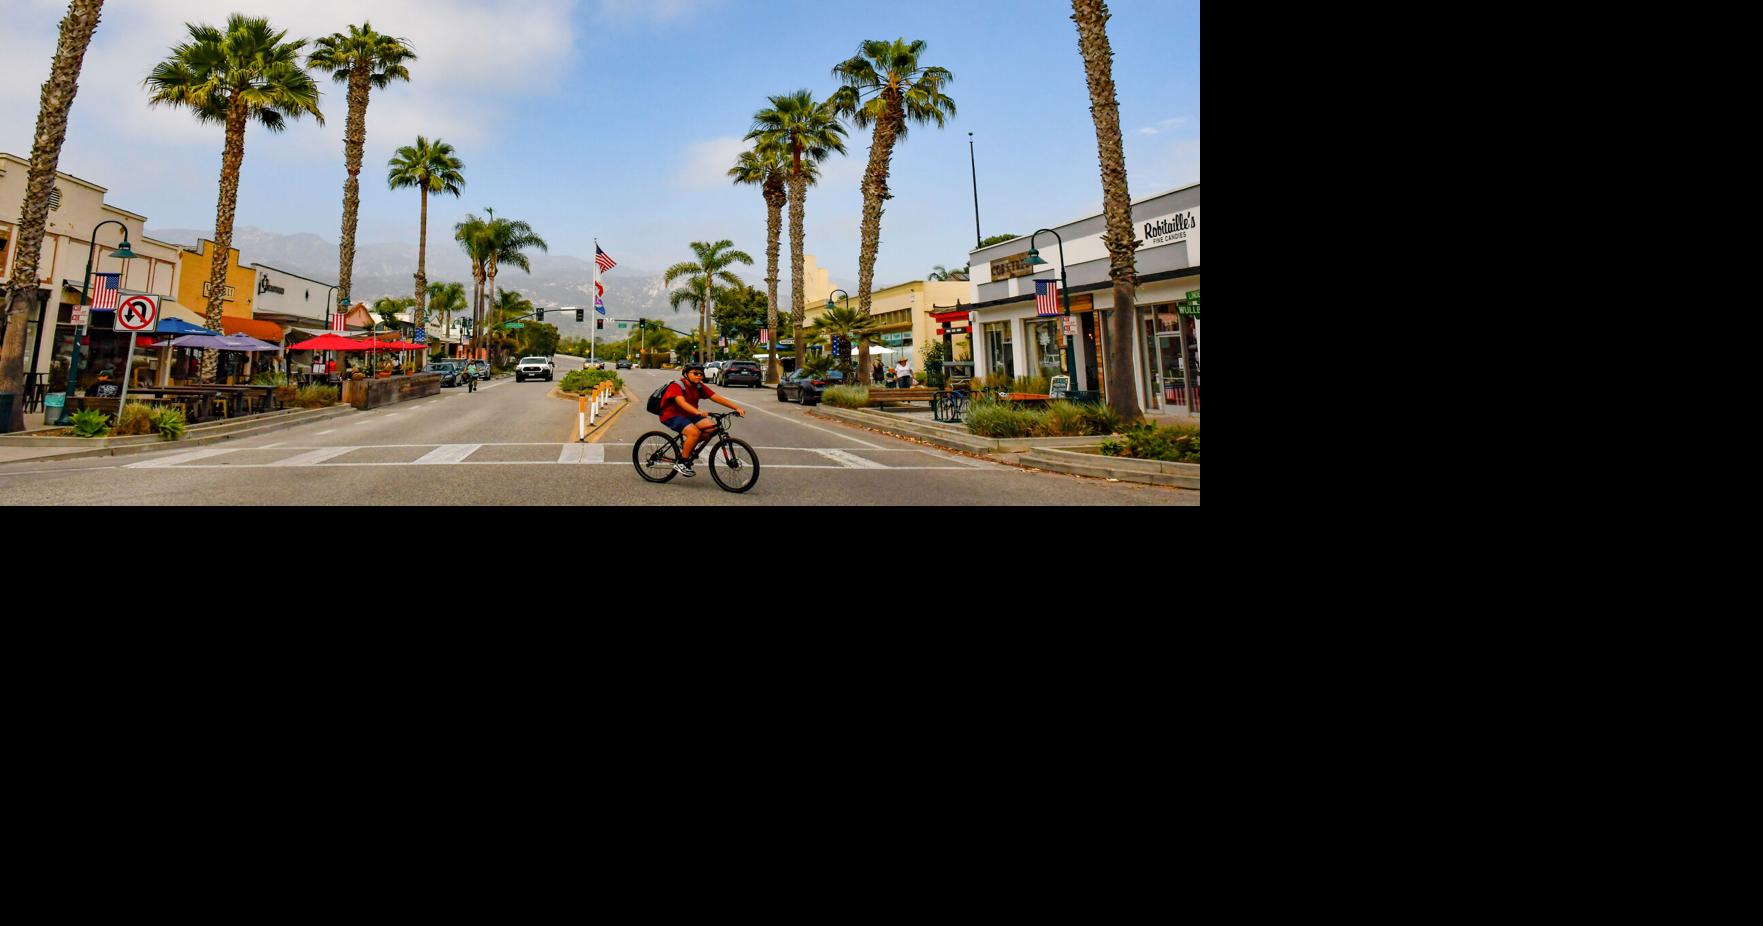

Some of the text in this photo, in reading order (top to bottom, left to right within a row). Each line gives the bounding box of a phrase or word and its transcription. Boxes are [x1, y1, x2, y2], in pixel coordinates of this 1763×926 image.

[1144, 211, 1196, 240] Robitaille's
[1153, 231, 1187, 244] FINE CANDIES
